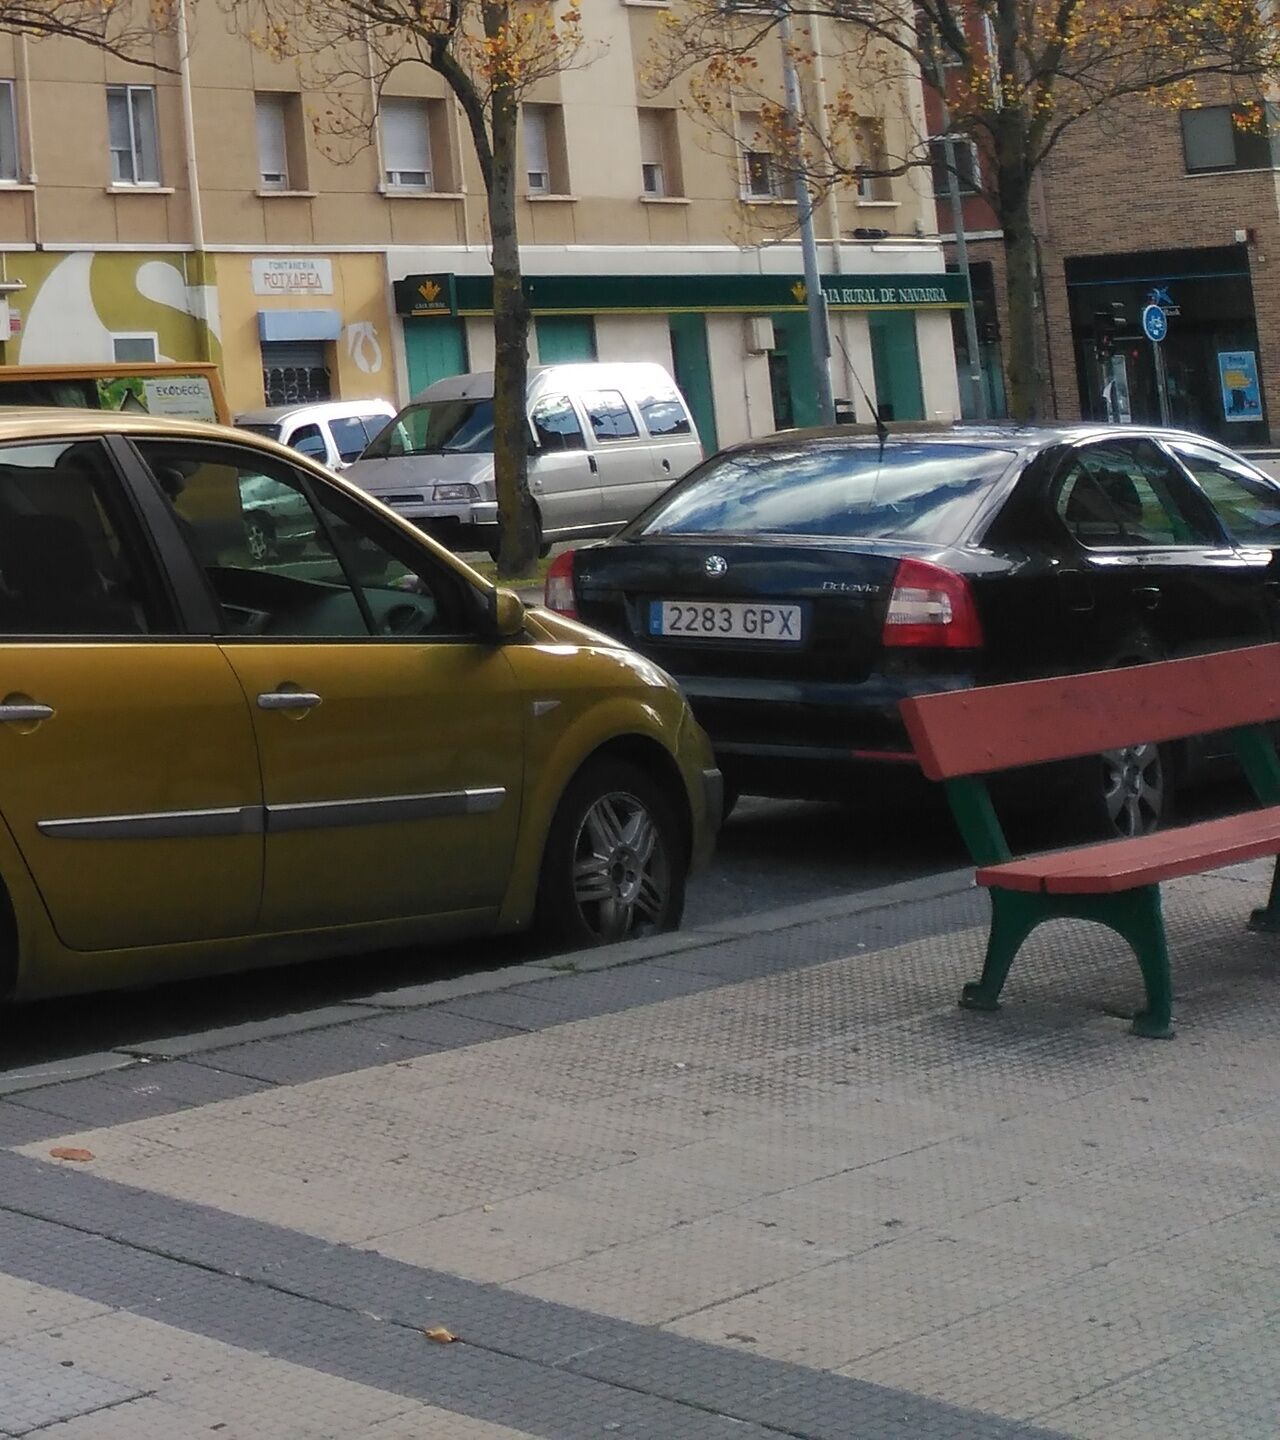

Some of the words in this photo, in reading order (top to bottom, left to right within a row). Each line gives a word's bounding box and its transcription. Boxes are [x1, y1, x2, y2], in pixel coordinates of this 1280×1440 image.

[842, 288, 879, 303] RURAL
[880, 288, 897, 302] DE
[898, 287, 948, 302] NAVARRA
[669, 606, 733, 632] 2283
[743, 609, 793, 635] GPX
